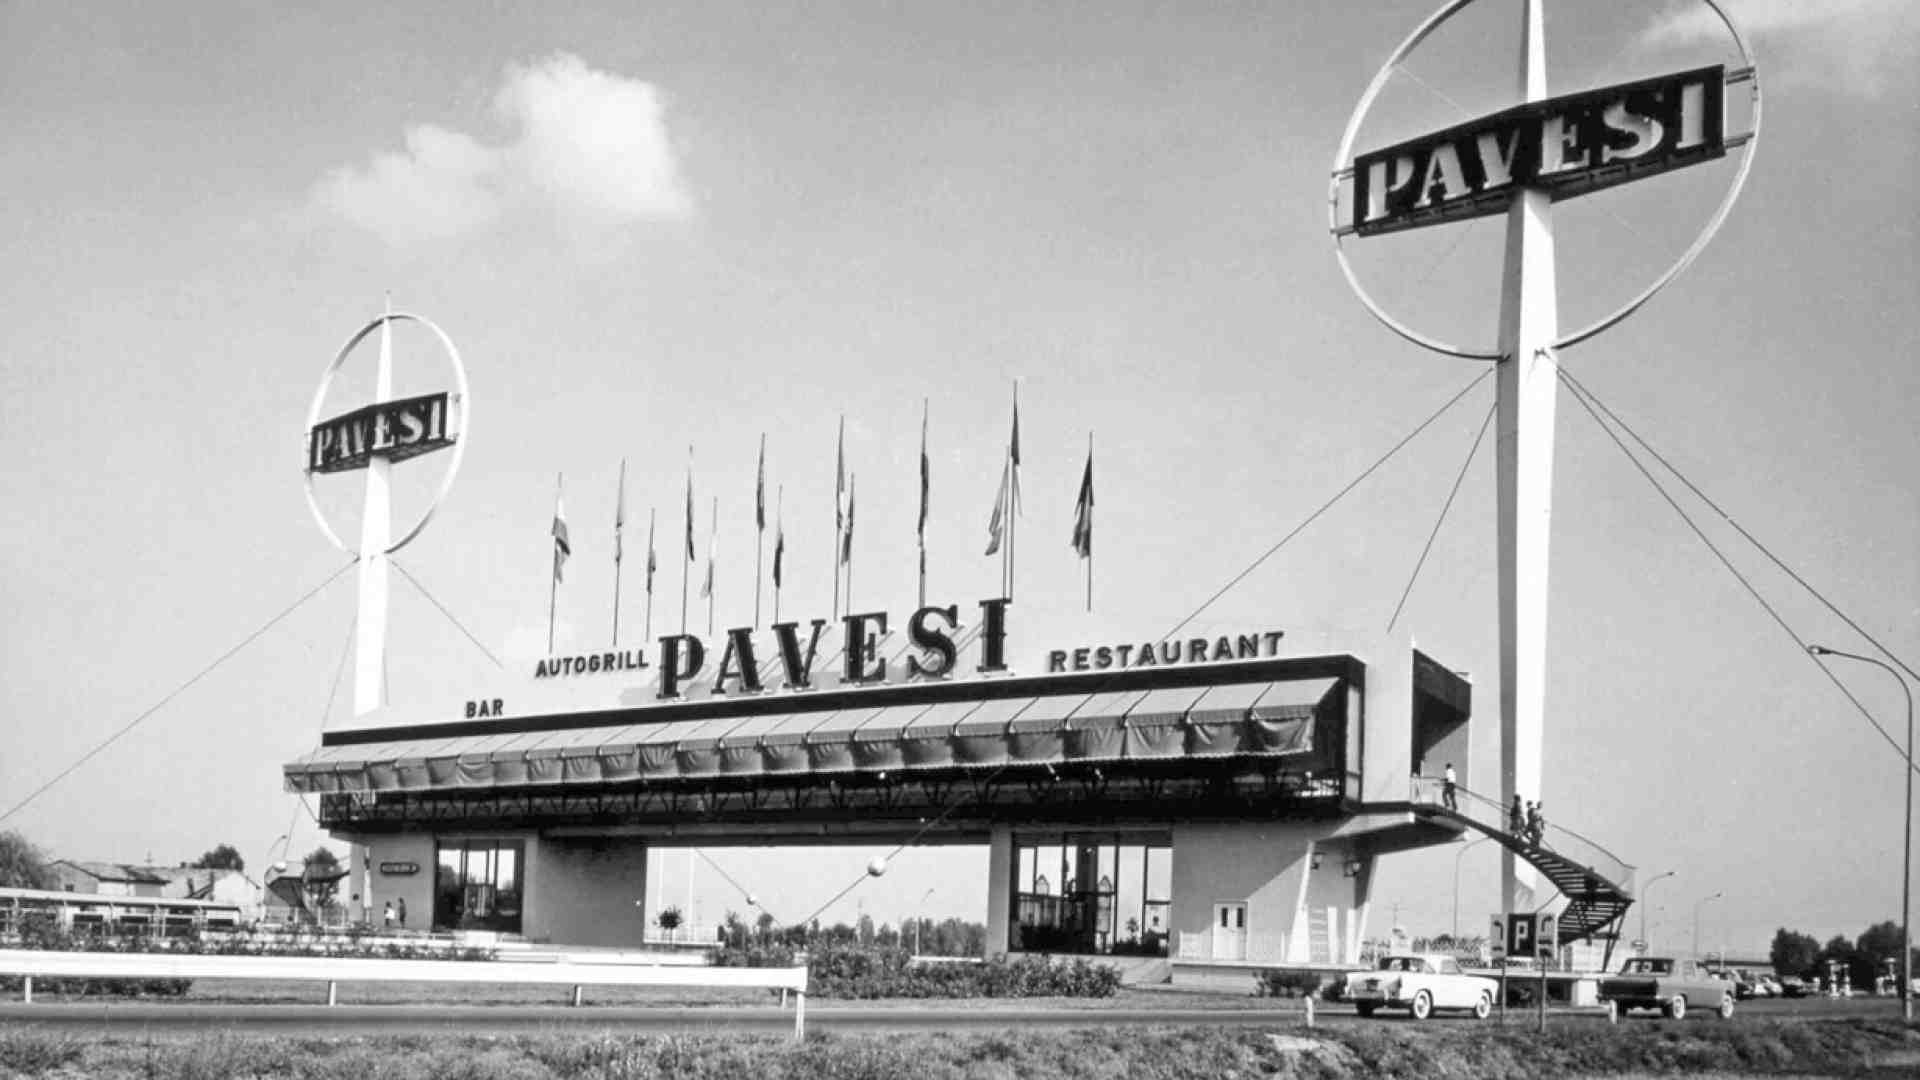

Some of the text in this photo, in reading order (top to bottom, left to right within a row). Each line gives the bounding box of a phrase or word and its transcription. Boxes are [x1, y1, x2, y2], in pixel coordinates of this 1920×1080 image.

[1364, 81, 1707, 222] PAVESI
[314, 400, 442, 467] PAVESI
[535, 597, 1285, 699] AUTOGRILL PAVESI RESTAURANT
[464, 698, 504, 719] BAR
[1514, 920, 1529, 951] P
